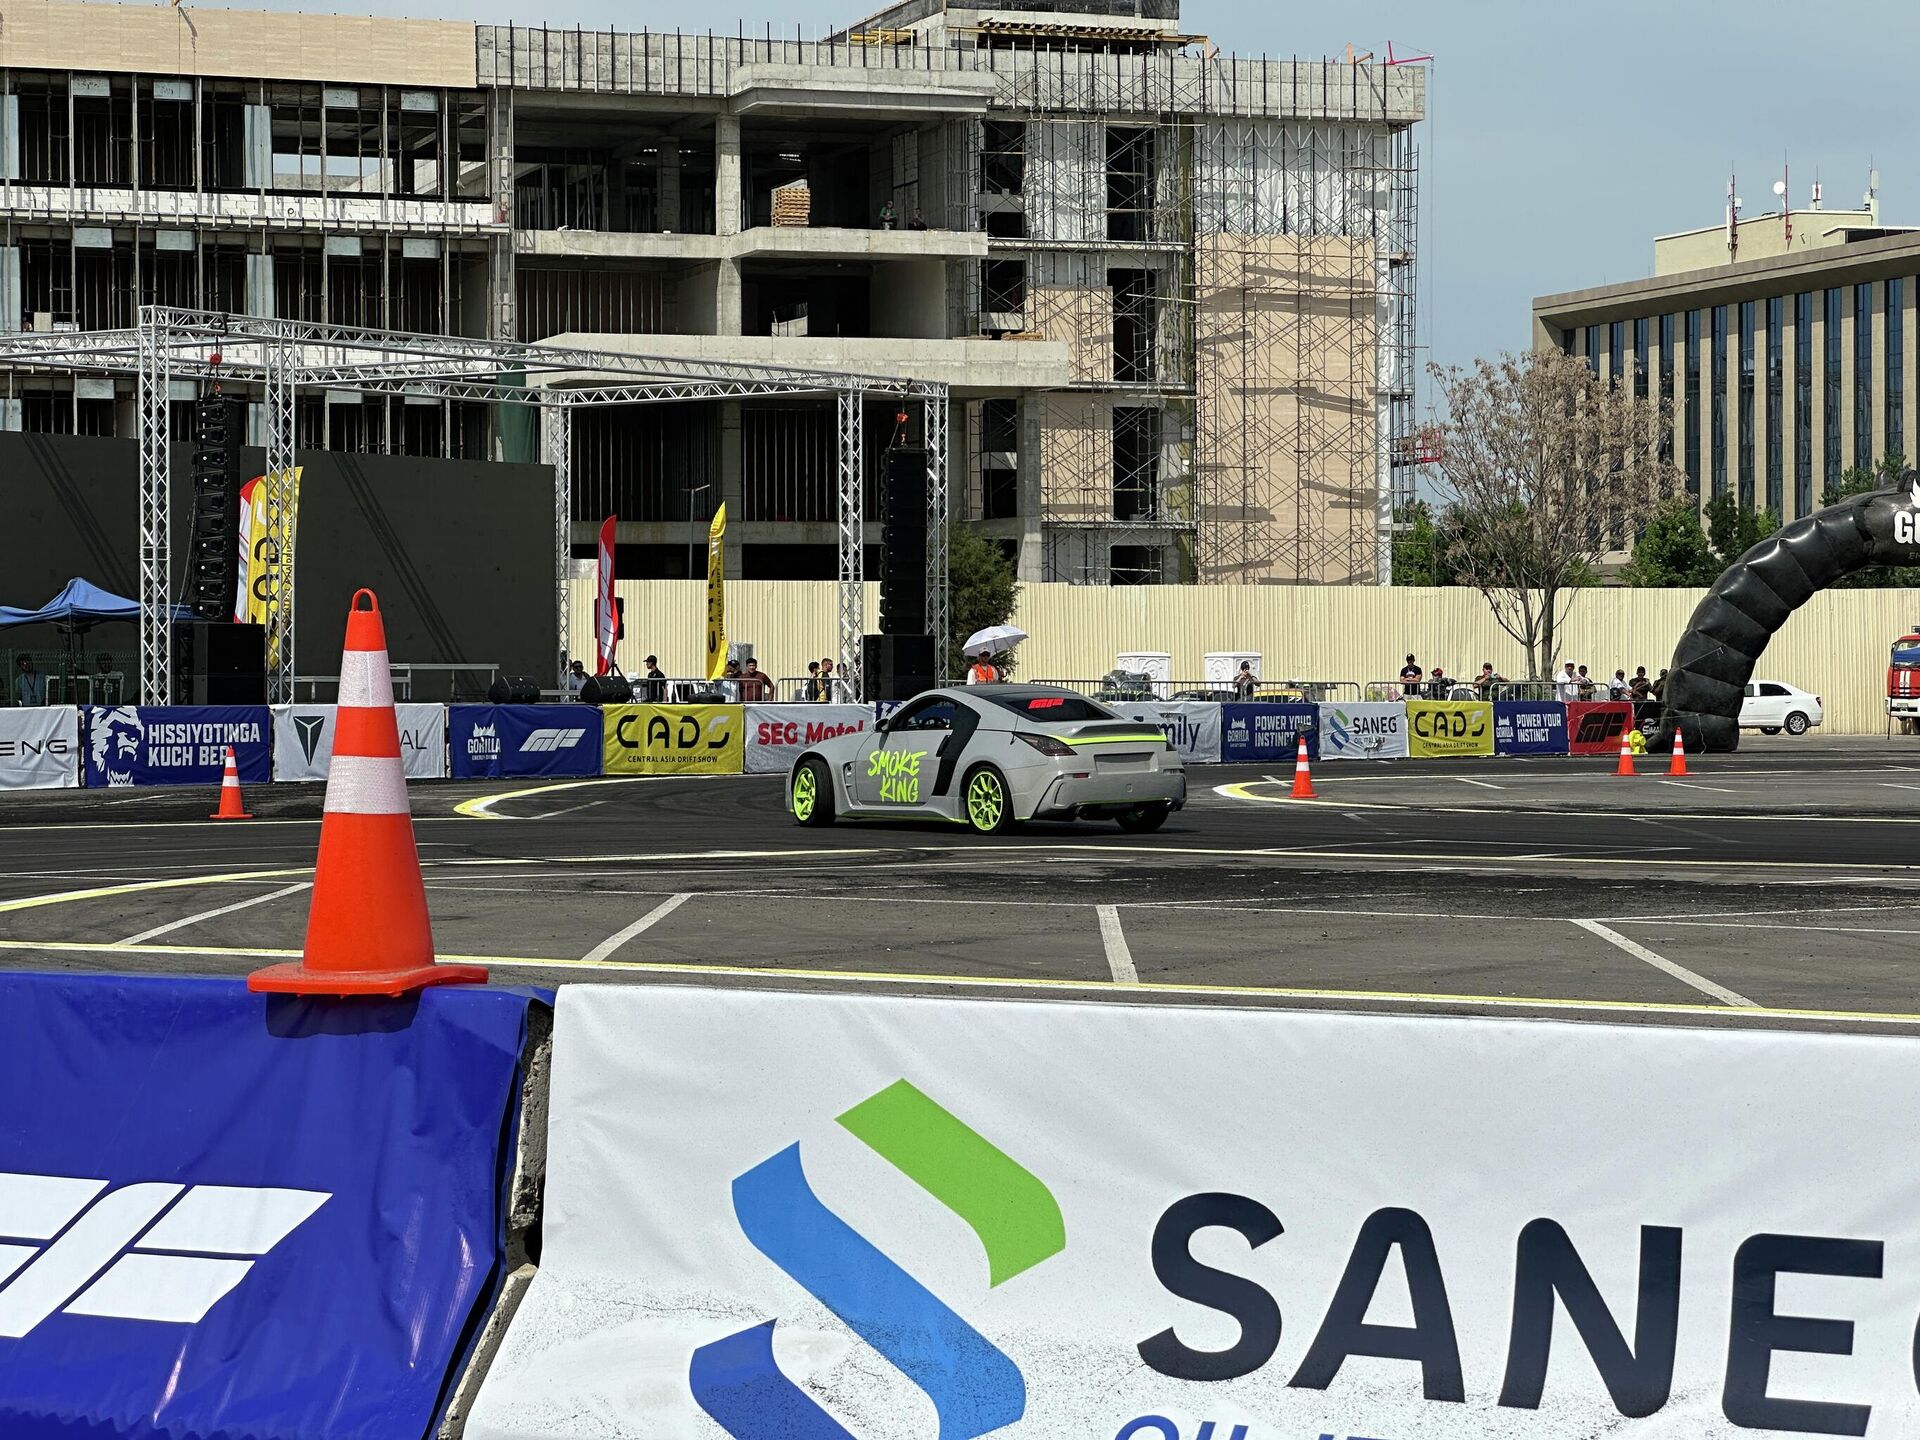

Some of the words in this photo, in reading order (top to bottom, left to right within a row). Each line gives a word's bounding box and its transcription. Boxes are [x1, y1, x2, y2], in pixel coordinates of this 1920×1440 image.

[1254, 715, 1287, 731] POWER
[1352, 716, 1397, 734] SANEG
[1516, 713, 1542, 728] POWER
[1543, 713, 1562, 727] YOUR
[147, 722, 261, 745] HISSIYOTINGA
[616, 714, 730, 749] CADS
[757, 722, 798, 746] SEG
[1254, 731, 1296, 748] INSTINCT
[1517, 728, 1549, 742] INSTINCT
[467, 737, 501, 754] GORILLA
[147, 746, 193, 767] KUCH
[198, 745, 229, 766] BER
[627, 755, 659, 763] CENTRAL
[660, 755, 676, 763] ASIA
[677, 755, 697, 763] DRIFT
[697, 755, 718, 763] SHOW
[867, 749, 928, 777] SMOKE
[879, 777, 919, 803] KING
[1137, 1192, 1920, 1437] SANE
